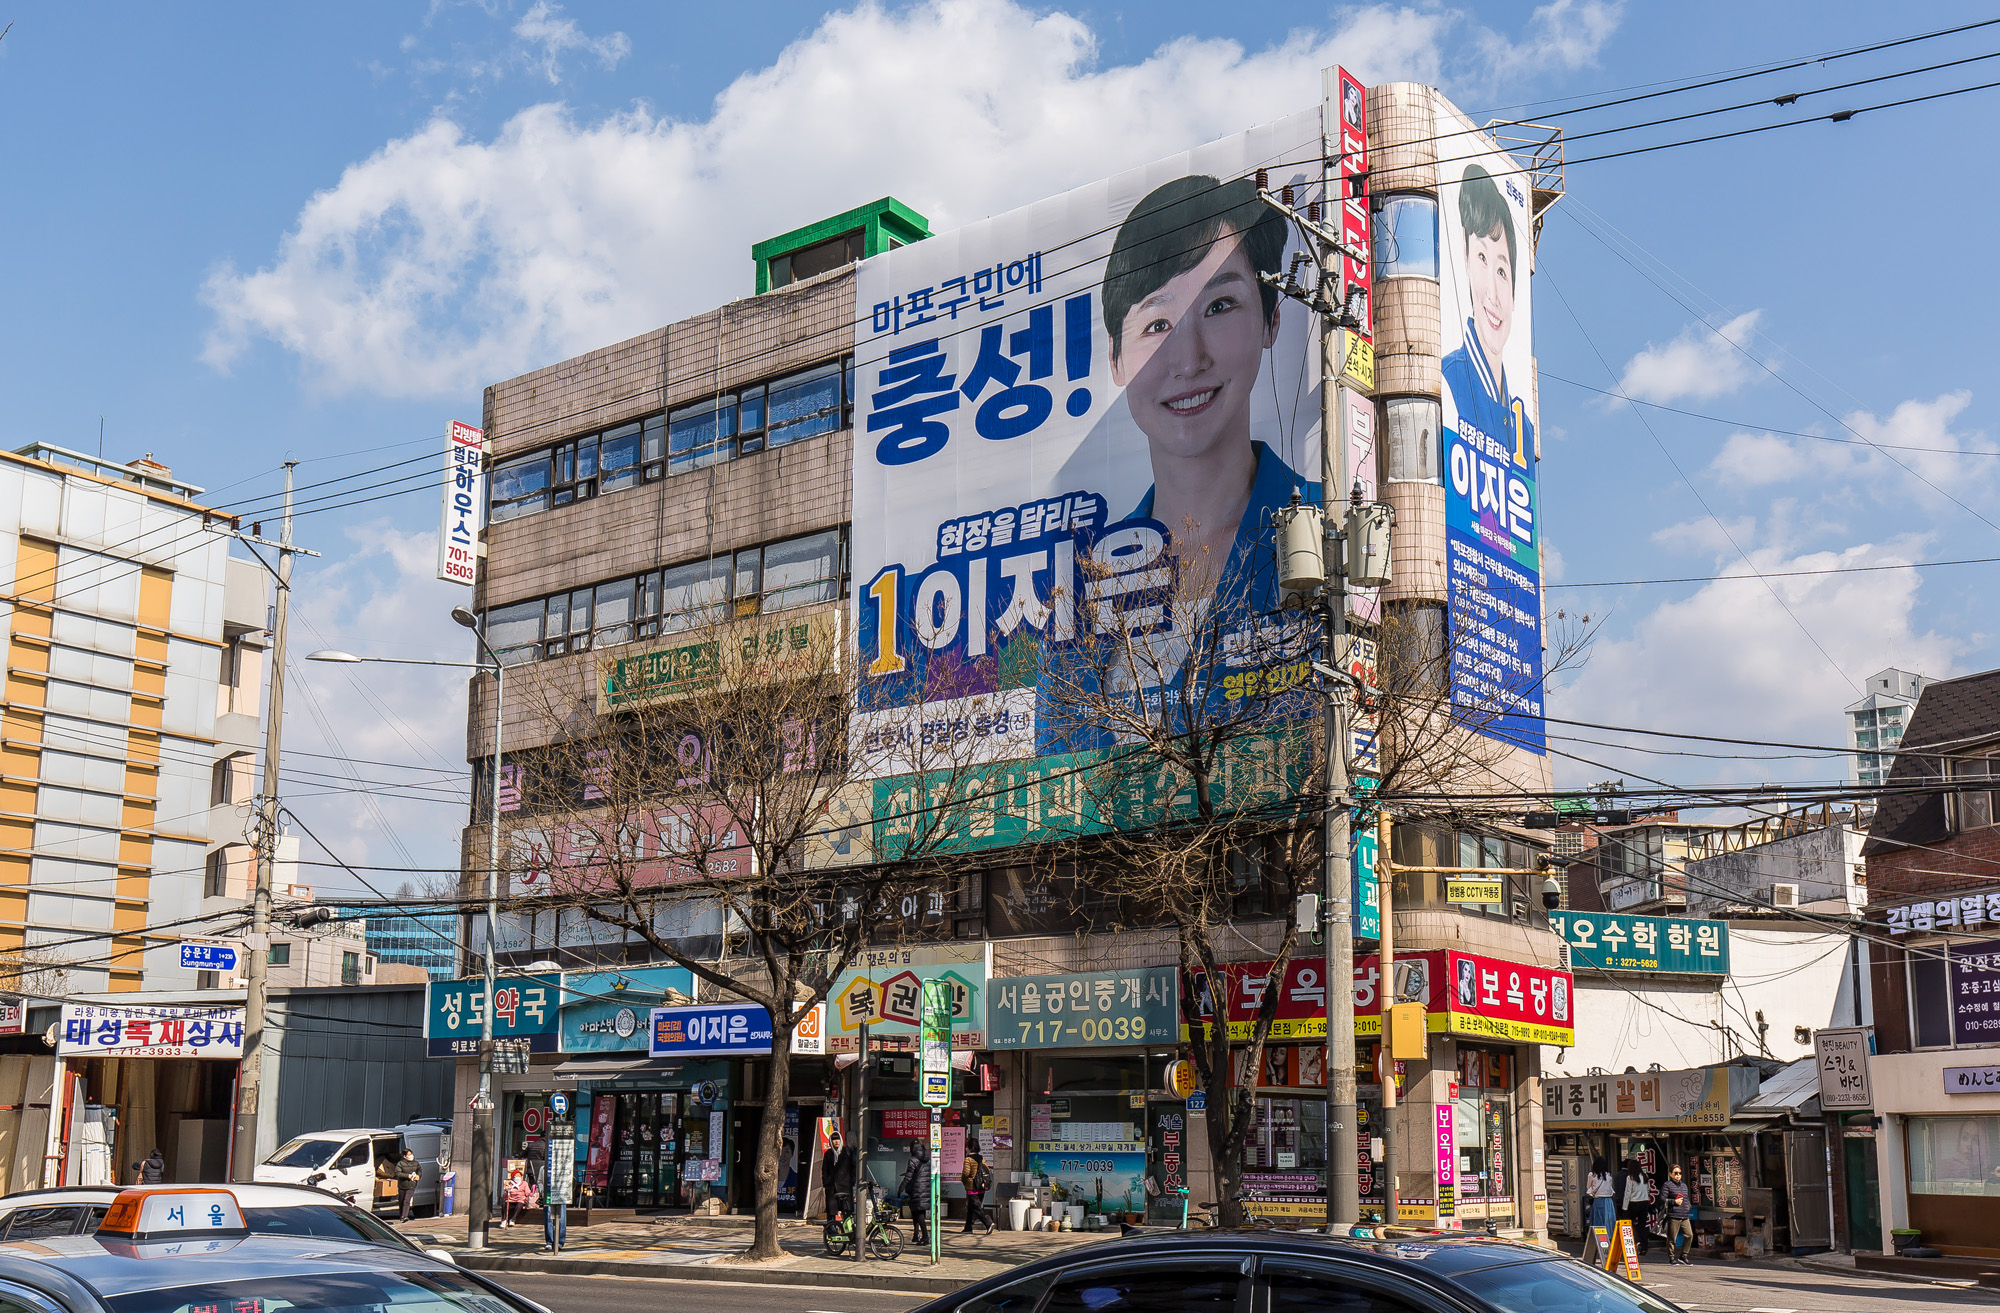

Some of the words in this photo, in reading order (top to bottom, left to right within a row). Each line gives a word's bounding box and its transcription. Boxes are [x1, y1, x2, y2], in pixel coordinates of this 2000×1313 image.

[872, 251, 1042, 335] 마포구민에
[866, 292, 1092, 466] 충성!
[1459, 418, 1485, 452] 현장을
[1485, 435, 1511, 468] 달리는
[1450, 442, 1533, 543] 이지은
[940, 511, 1016, 557] 현장을
[1019, 494, 1099, 538] 달리는
[445, 562, 474, 580] 5503
[868, 571, 906, 677] 1
[914, 526, 1174, 657] 이지은
[664, 860, 738, 880] T.7122582
[1466, 886, 1483, 899] CCTV
[575, 934, 596, 943] Dental
[1667, 923, 1720, 957] 학원
[182, 958, 225, 969] Sungmun-gil
[901, 951, 911, 964] 집
[997, 976, 1170, 1015] 서울공인중개사
[1481, 967, 1548, 1017] 보옥당
[208, 1008, 236, 1020] MDF
[440, 987, 547, 1030] 성도약국
[1958, 1002, 1989, 1014] 소수정예
[66, 1017, 244, 1048] 태성목재상사
[580, 1018, 615, 1034] 아마스빈
[687, 1014, 749, 1045] 이지은
[1018, 1016, 1146, 1044] 717-0039
[1298, 1022, 1327, 1035] 715-98
[451, 1040, 481, 1054] 의료보
[1175, 1067, 1196, 1091] 부동산
[1839, 1074, 1864, 1091] 바디
[1189, 1100, 1205, 1108] 127
[1546, 1082, 1608, 1117] 태종대
[1616, 1077, 1661, 1113] 갈비
[1157, 1113, 1183, 1130] 서울
[1674, 1113, 1725, 1124] T.718-8558
[1438, 1109, 1451, 1181] 보옥당
[1060, 1159, 1114, 1173] 717-0039
[1163, 1131, 1181, 1194] 부동산
[1356, 1131, 1373, 1195] 보옥당
[787, 1186, 795, 1194] 3F
[1154, 1197, 1184, 1208] 717-00
[166, 1203, 226, 1227] 서울
